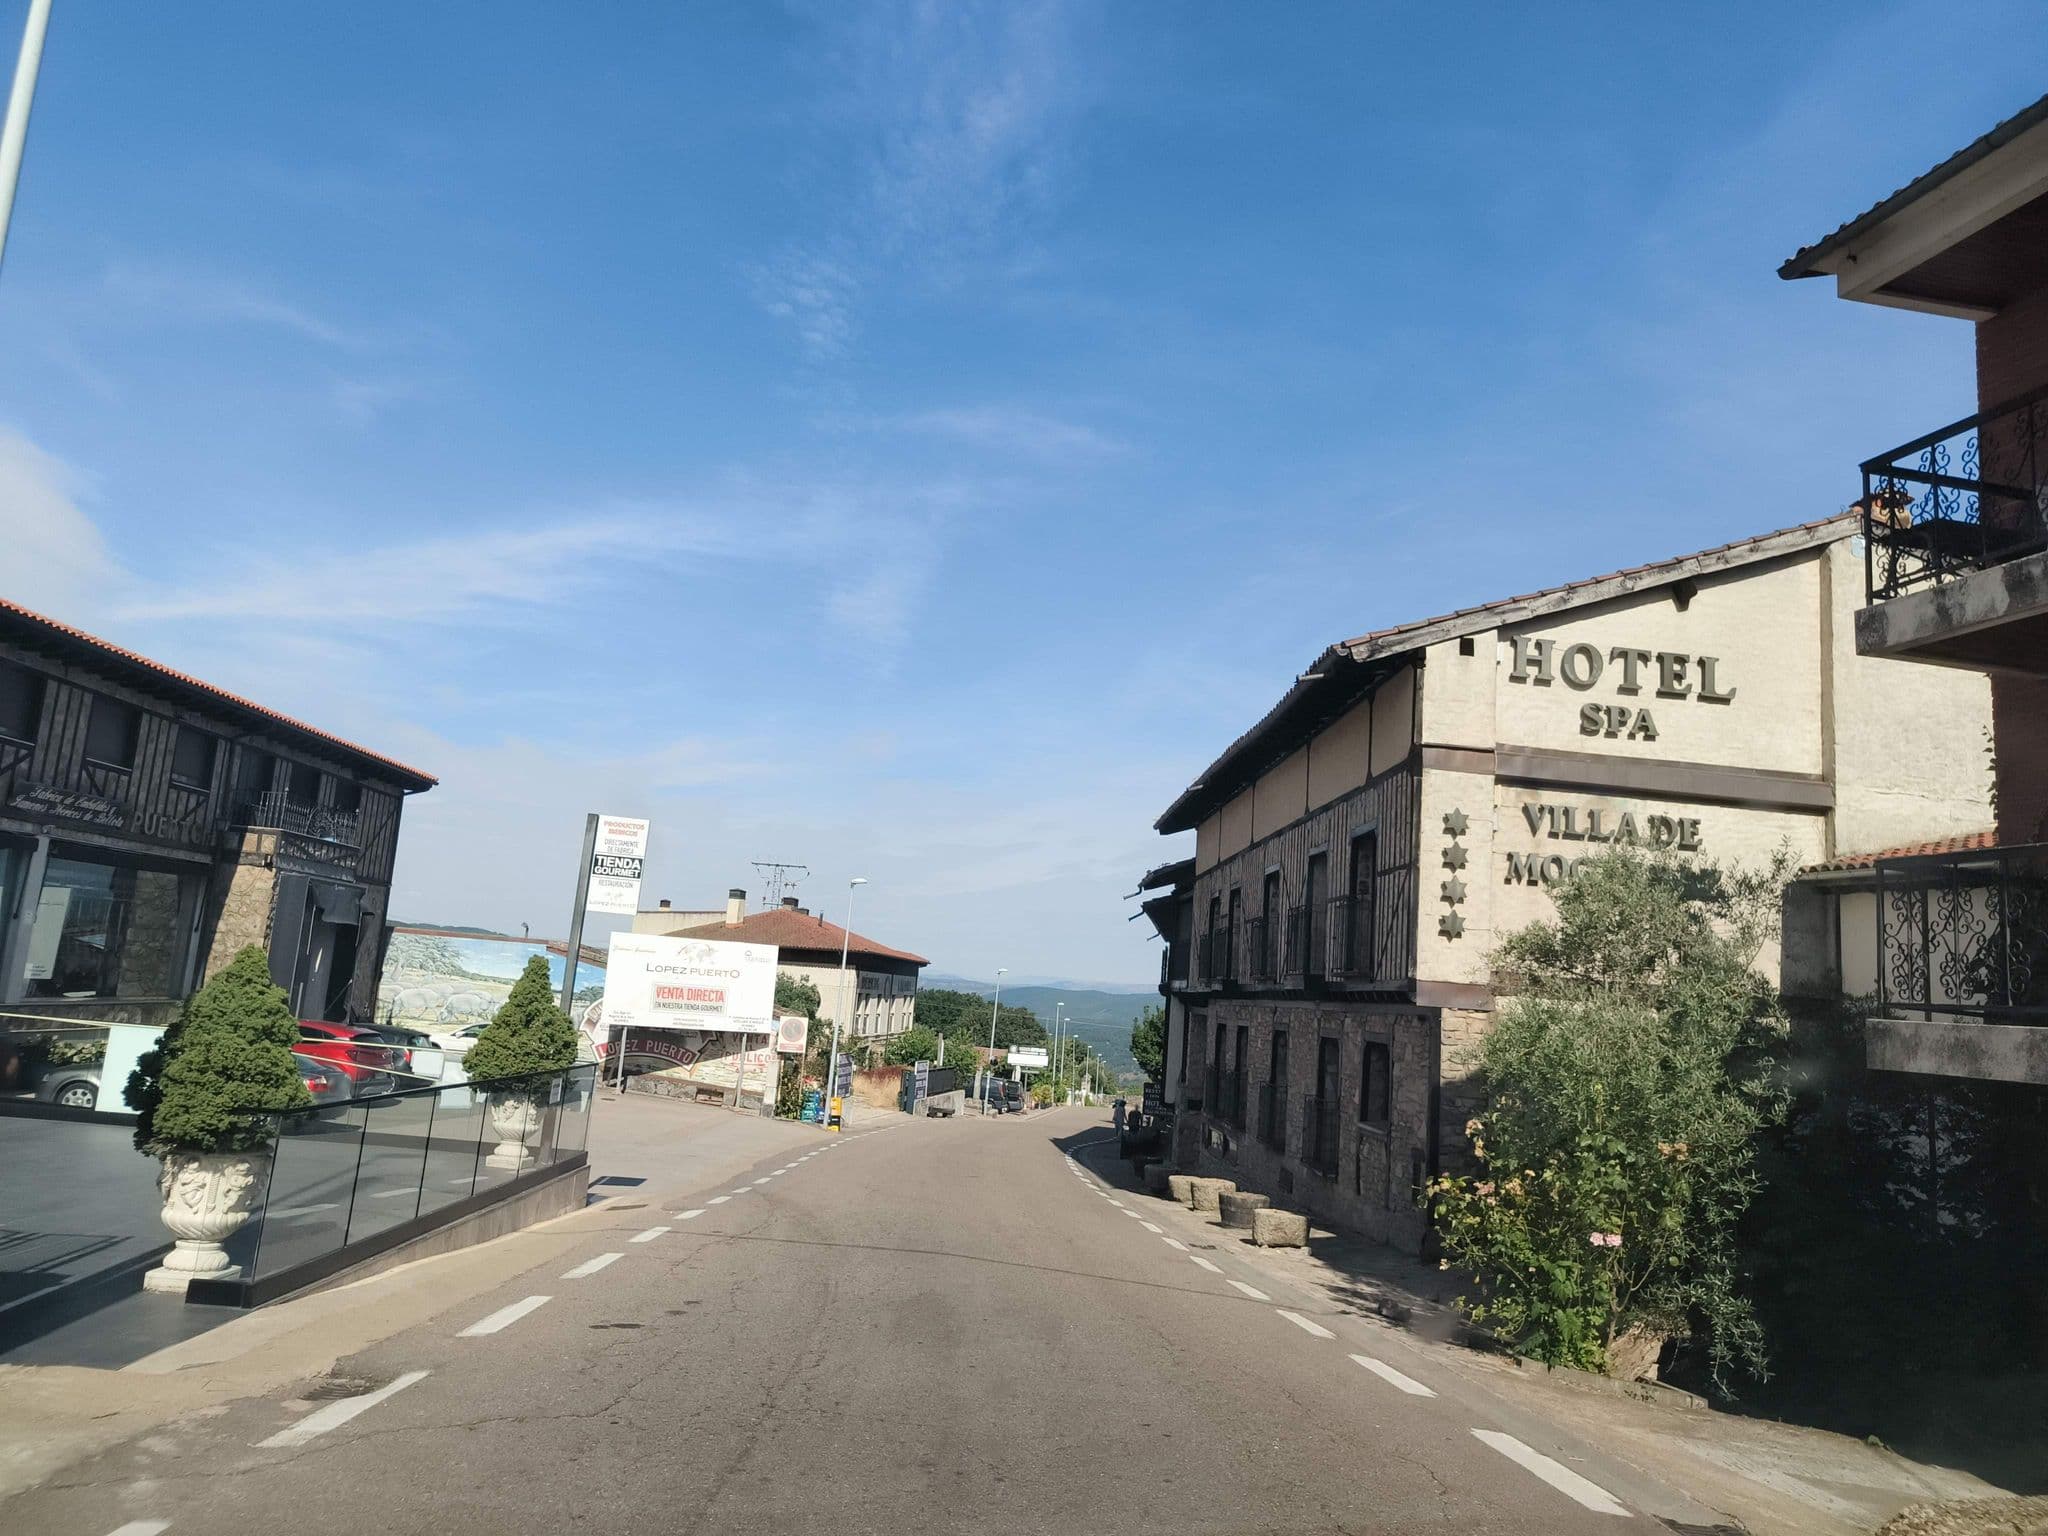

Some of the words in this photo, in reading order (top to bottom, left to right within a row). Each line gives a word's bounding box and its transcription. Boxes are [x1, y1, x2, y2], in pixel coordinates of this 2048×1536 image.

[1509, 635, 1737, 705] HOTEL
[1580, 703, 1660, 741] SPA
[604, 821, 645, 830] PRODUCTOS
[1522, 802, 1640, 846] VILLA
[1648, 814, 1703, 852] DE
[596, 855, 641, 870] TIENDA
[594, 866, 641, 878] GOURMET
[646, 962, 687, 975] LOPEZ
[690, 968, 741, 979] PUERTO
[656, 986, 684, 1001] VENTA
[687, 988, 725, 1003] DIRECTA
[655, 1001, 661, 1009] EN
[662, 1002, 683, 1010] NUESTRA
[684, 1003, 700, 1011] TIENDA
[701, 1005, 723, 1013] GOURMET
[595, 1039, 639, 1057] LOPEZ
[646, 1040, 692, 1064] PUERTO
